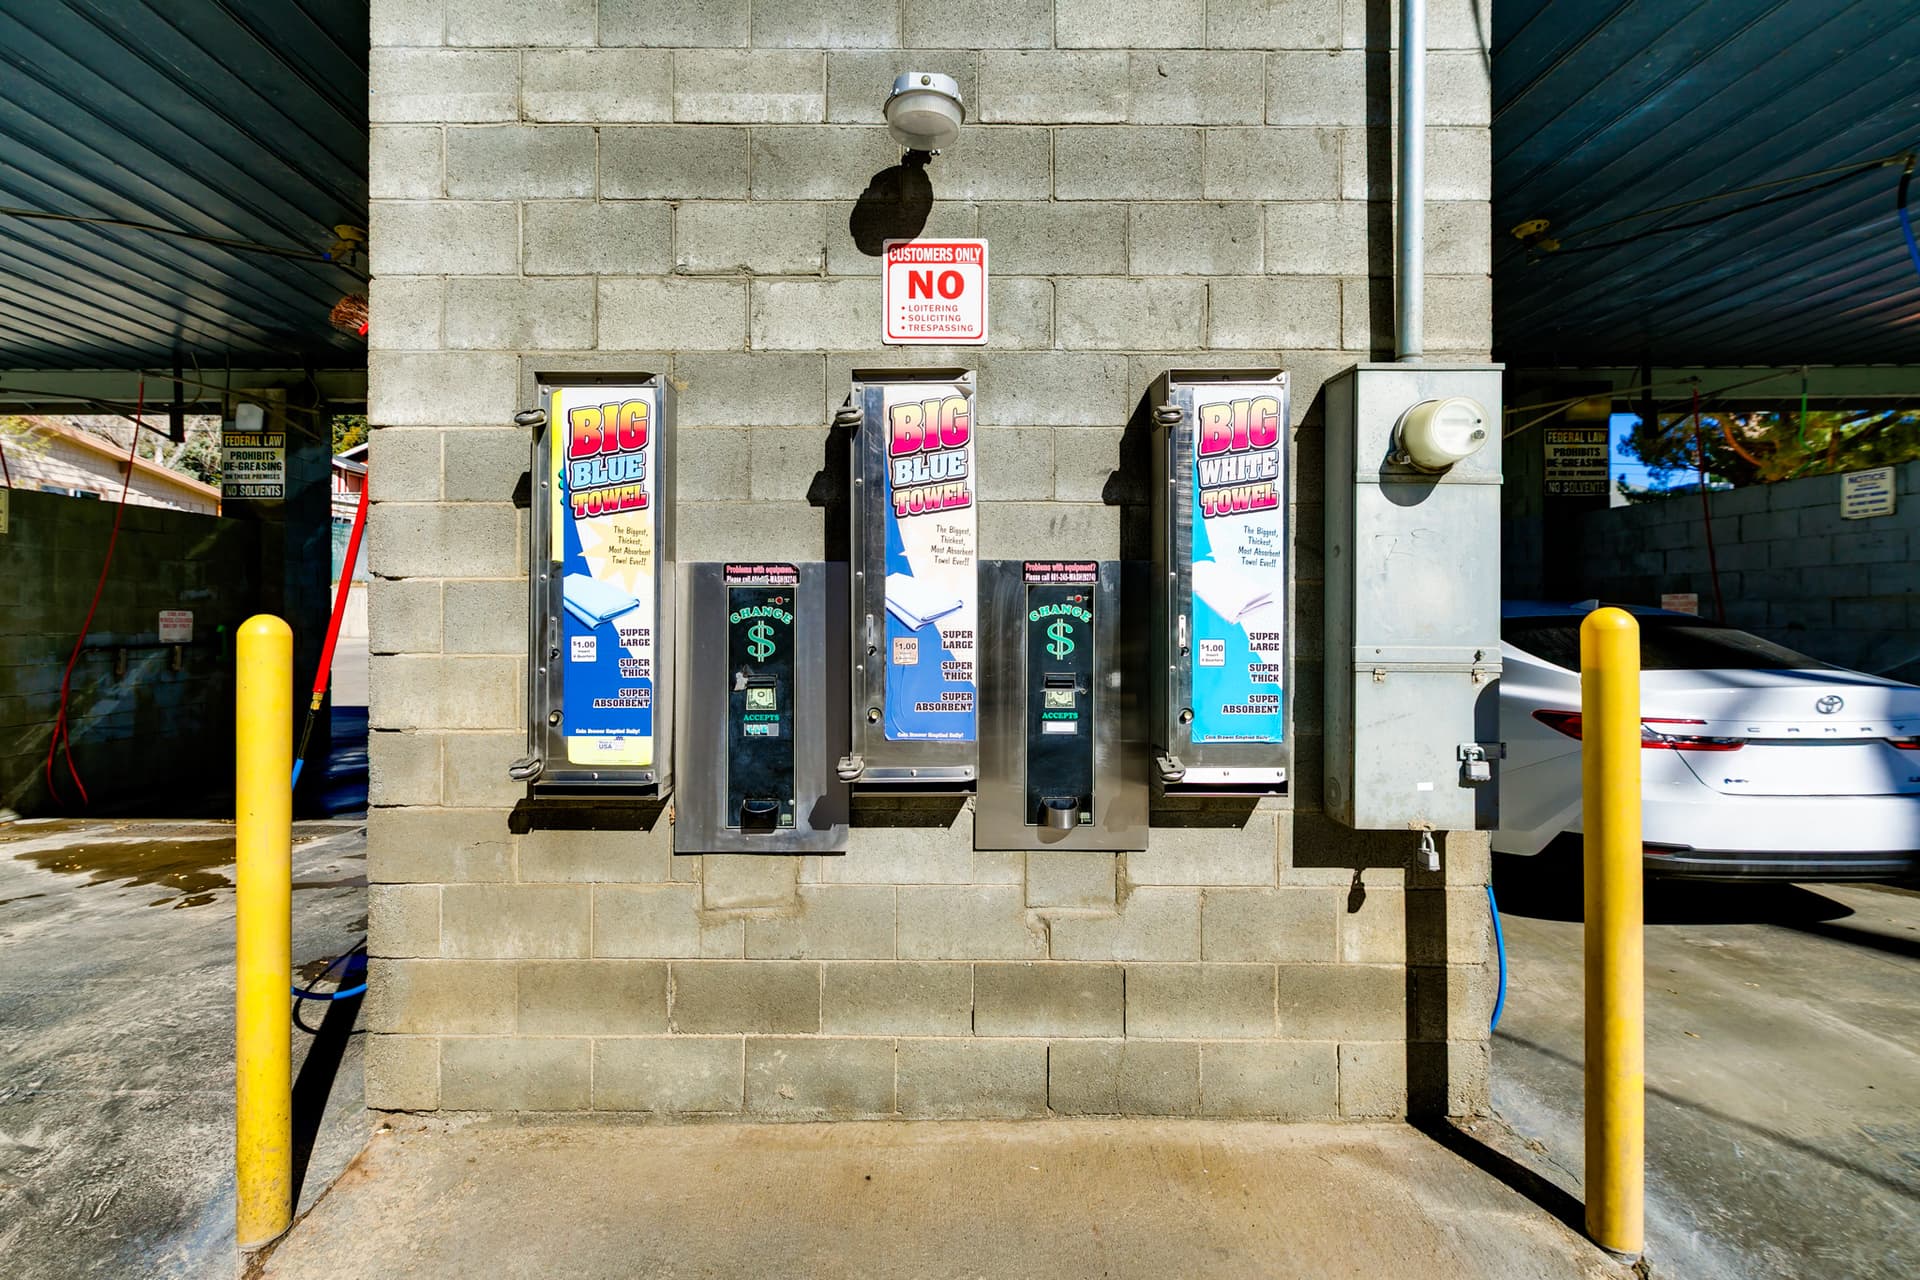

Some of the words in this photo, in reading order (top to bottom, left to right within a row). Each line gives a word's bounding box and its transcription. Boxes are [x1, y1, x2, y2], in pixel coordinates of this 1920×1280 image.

[890, 248, 953, 262] CUSTOMERS
[955, 248, 982, 262] ONLY
[908, 270, 964, 300] NO
[569, 400, 650, 458] BIG
[890, 396, 970, 456] BIG
[1200, 396, 1279, 456] BIG
[225, 436, 261, 446] FEDERAL
[264, 436, 282, 446] LAW
[1548, 432, 1585, 443] FEDERAL
[1588, 432, 1607, 443] LAW
[230, 451, 275, 460] PROHIBITS
[1554, 448, 1600, 456] PROHIBITS
[224, 462, 282, 470] DE-GREASING
[571, 452, 645, 488] BLUE
[893, 450, 966, 486] BLUE
[1200, 450, 1278, 486] WHITE
[226, 485, 237, 496] NO
[240, 485, 281, 496] SOLVENTS
[1548, 482, 1560, 493] NO
[1563, 482, 1605, 493] SOLVENTS
[572, 484, 648, 516] TOWEL
[894, 482, 970, 515] TOWEL
[1202, 482, 1278, 516] TOWEL
[614, 525, 624, 534] The
[936, 524, 946, 533] The
[1244, 525, 1254, 534] The
[624, 547, 650, 556] Absorbent
[931, 545, 944, 553] Most
[946, 546, 973, 555] Absorbent
[1238, 546, 1252, 554] Most
[1254, 548, 1280, 557] Absorbent
[612, 556, 627, 564] Towel
[935, 555, 950, 564] Towel
[1241, 556, 1257, 566] Towel
[726, 565, 752, 574] Problems
[753, 565, 764, 573] with
[1025, 563, 1051, 571] Problems
[1052, 563, 1064, 571] with
[1064, 563, 1096, 572] equipment?
[730, 606, 793, 625] CHANGE
[1029, 604, 1092, 623] CHANGE
